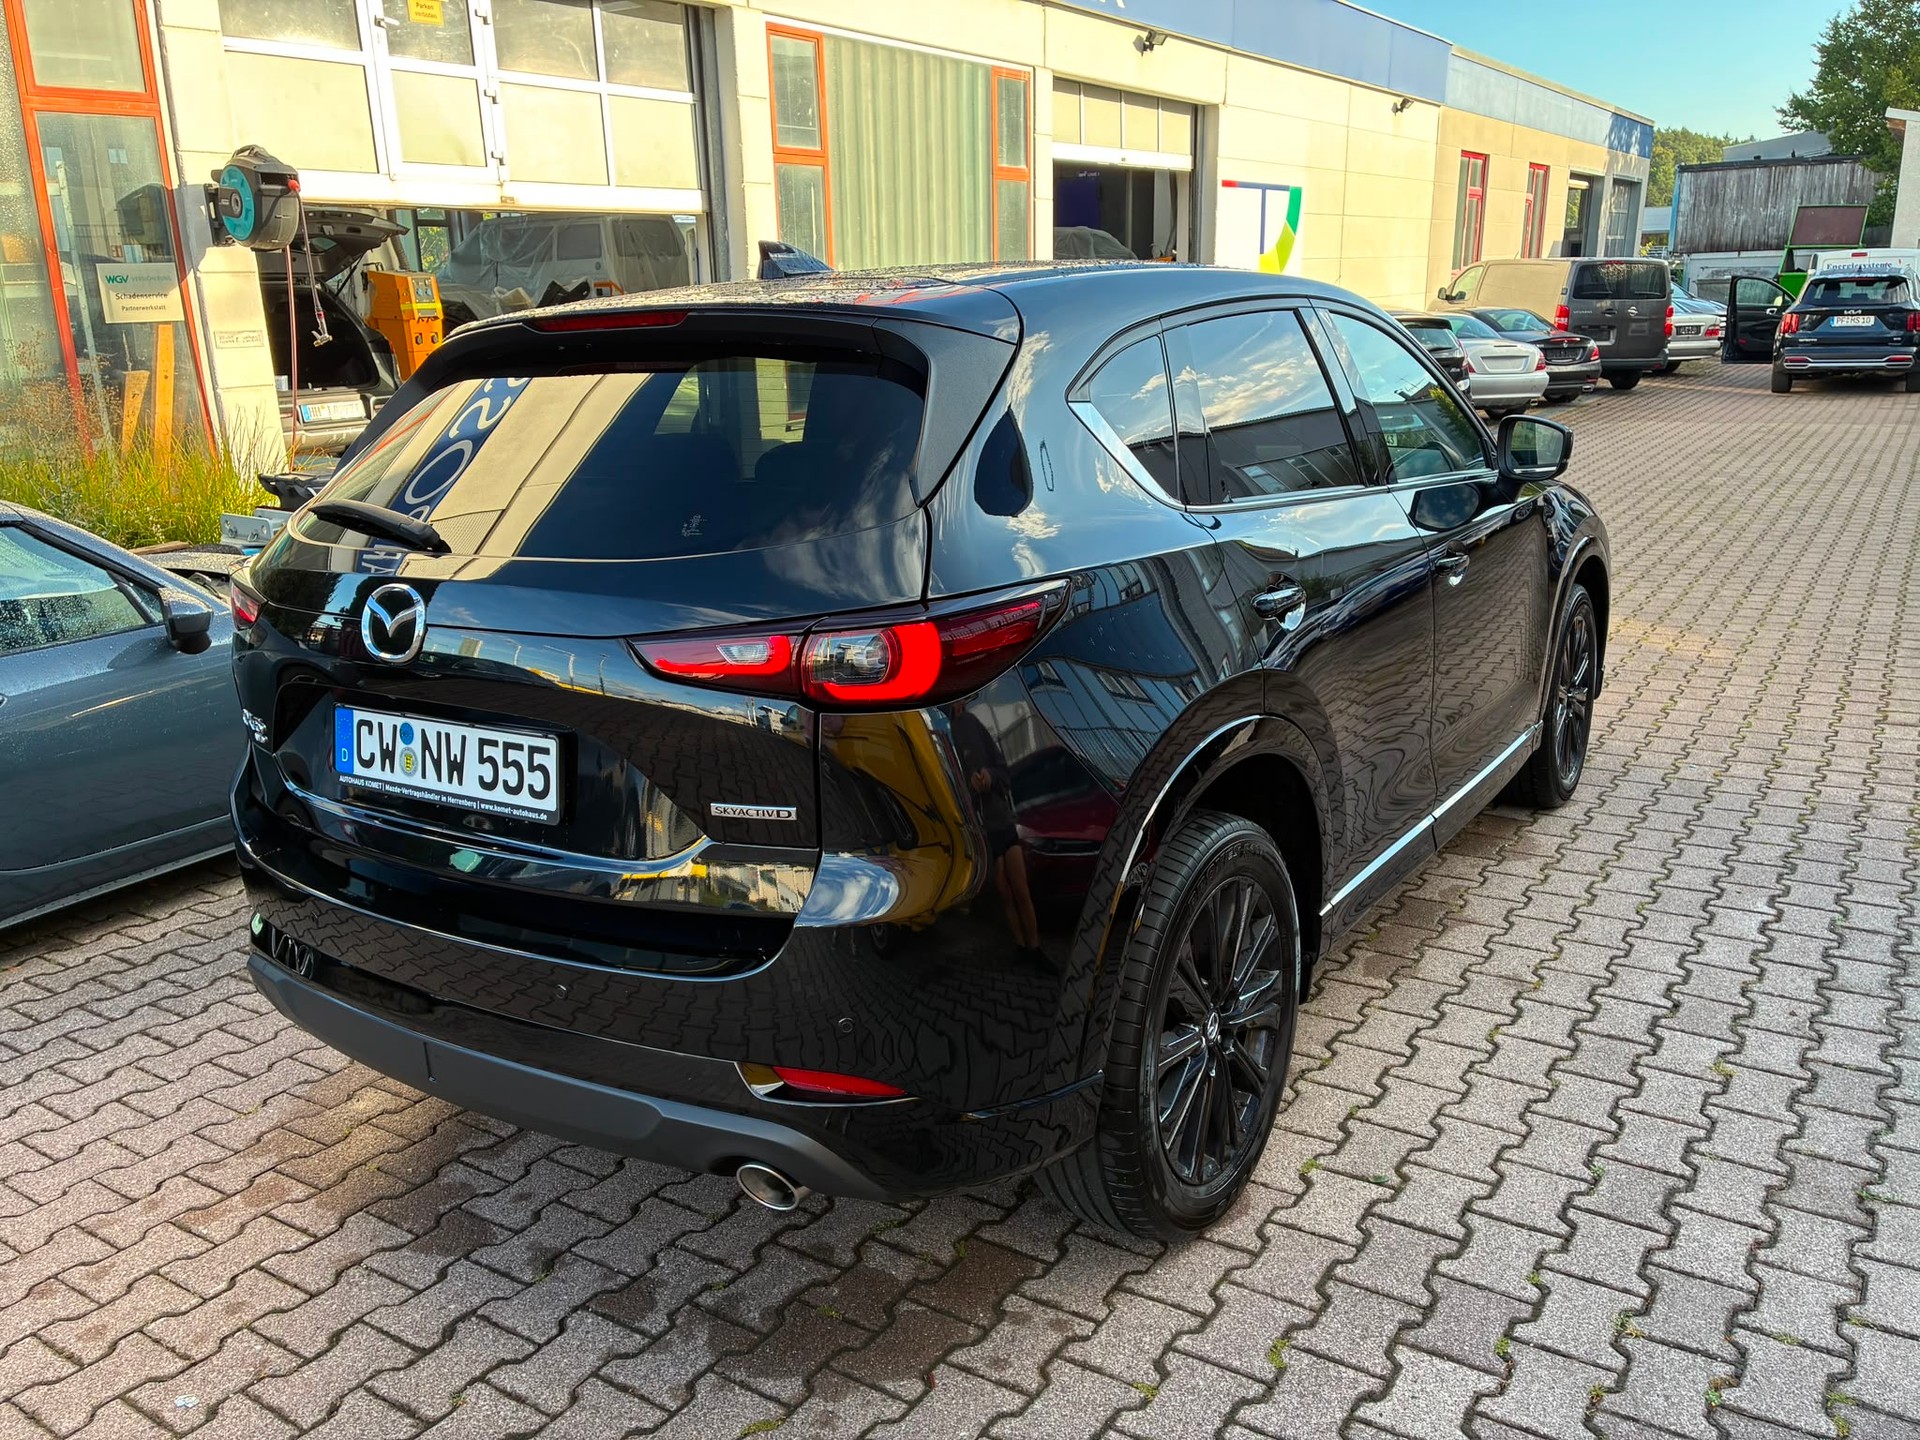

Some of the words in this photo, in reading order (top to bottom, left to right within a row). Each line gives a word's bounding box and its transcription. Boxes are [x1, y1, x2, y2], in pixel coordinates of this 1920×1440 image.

[105, 275, 129, 284] WGV
[115, 292, 168, 301] Schadenservice
[341, 747, 349, 762] D
[356, 718, 398, 774] CW
[420, 728, 467, 787] NW
[477, 737, 551, 801] 555
[339, 775, 365, 787] AUTOHAUS
[365, 780, 382, 791] KOMET
[448, 796, 477, 809] Herrenberg
[480, 803, 548, 821] www.komet-autohaus.de
